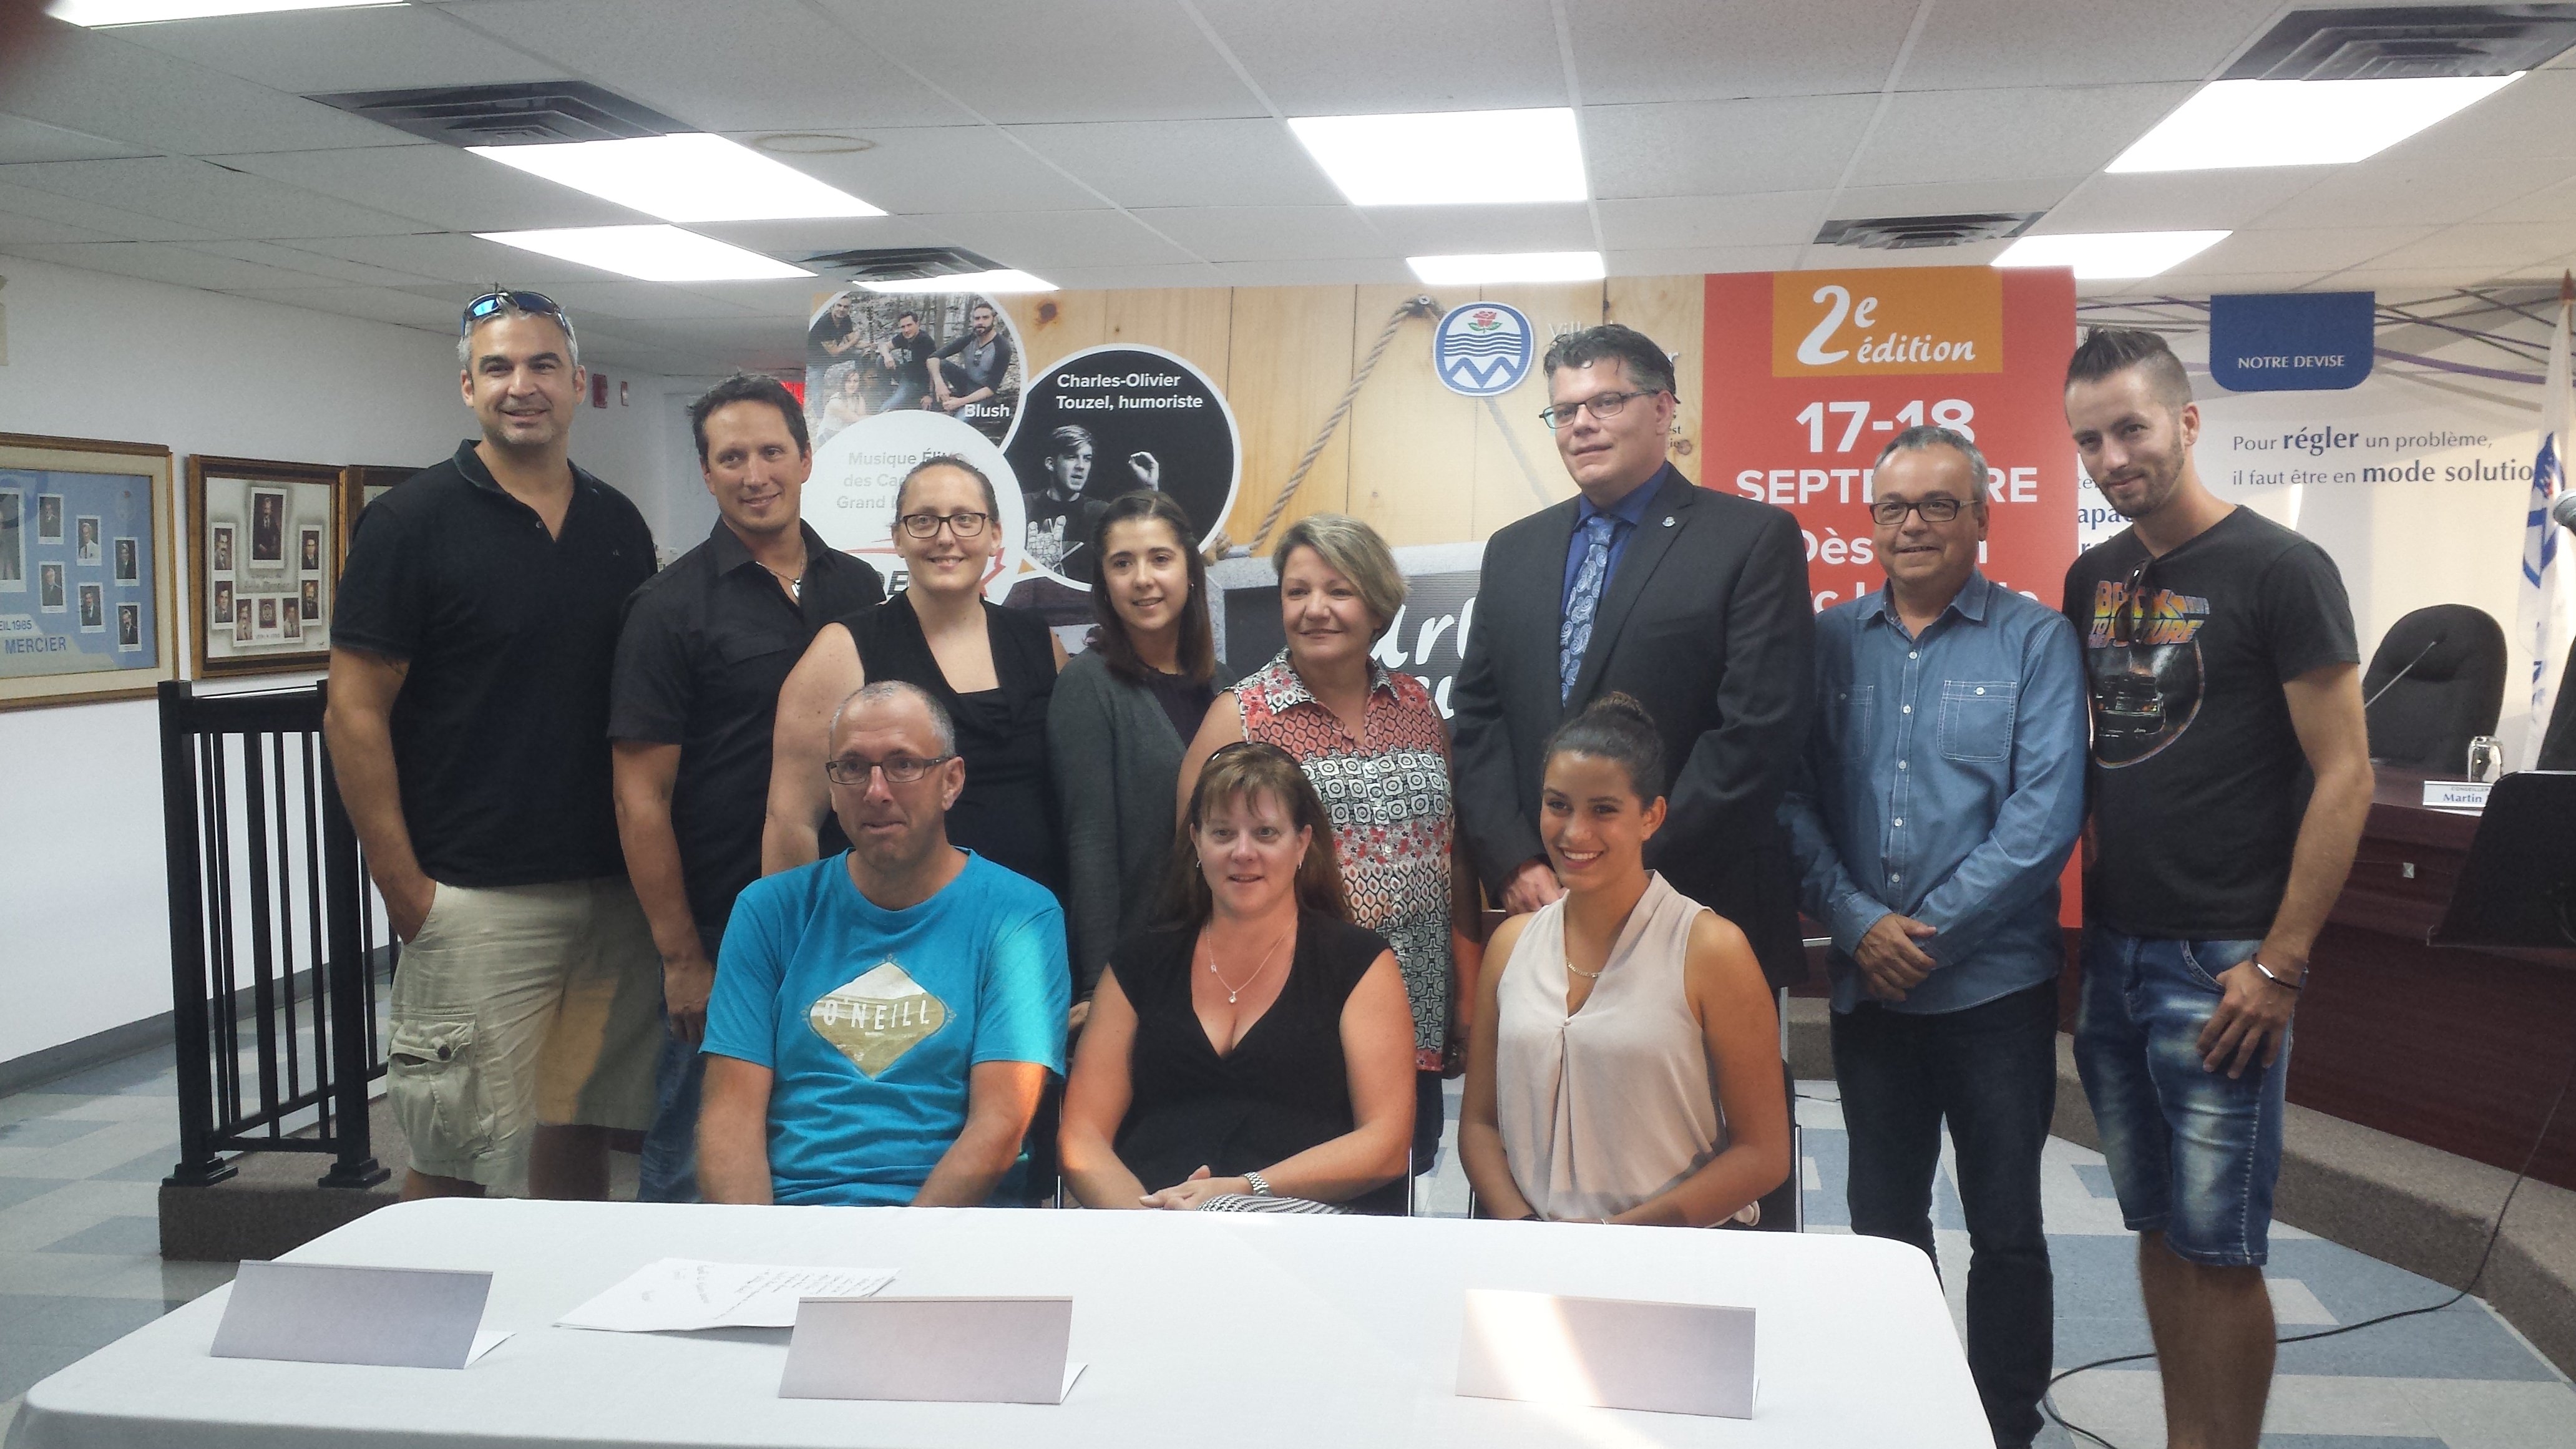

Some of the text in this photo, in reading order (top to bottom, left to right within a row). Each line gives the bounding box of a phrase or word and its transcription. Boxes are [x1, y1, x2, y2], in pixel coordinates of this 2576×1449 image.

[1856, 332, 1976, 364] édition
[2238, 355, 2346, 369] NOTRE DEVISE
[1056, 373, 1181, 388] Charles-Olivier
[1056, 394, 1203, 411] Touzel, humoriste
[965, 404, 1010, 417] Blush
[2233, 426, 2492, 456] Pour régler un problème,
[849, 452, 917, 467] Musique
[2233, 471, 2243, 485] il
[2250, 469, 2285, 485] faut
[2291, 469, 2327, 484] être
[2334, 472, 2356, 483] en
[2363, 459, 2436, 482] mode
[844, 474, 872, 487] des
[837, 496, 886, 508] Grand
[12, 620, 32, 630] 1985
[5, 636, 67, 654] MERCIER
[2443, 793, 2482, 803] Martin
[823, 999, 930, 1030] O'NEILL
